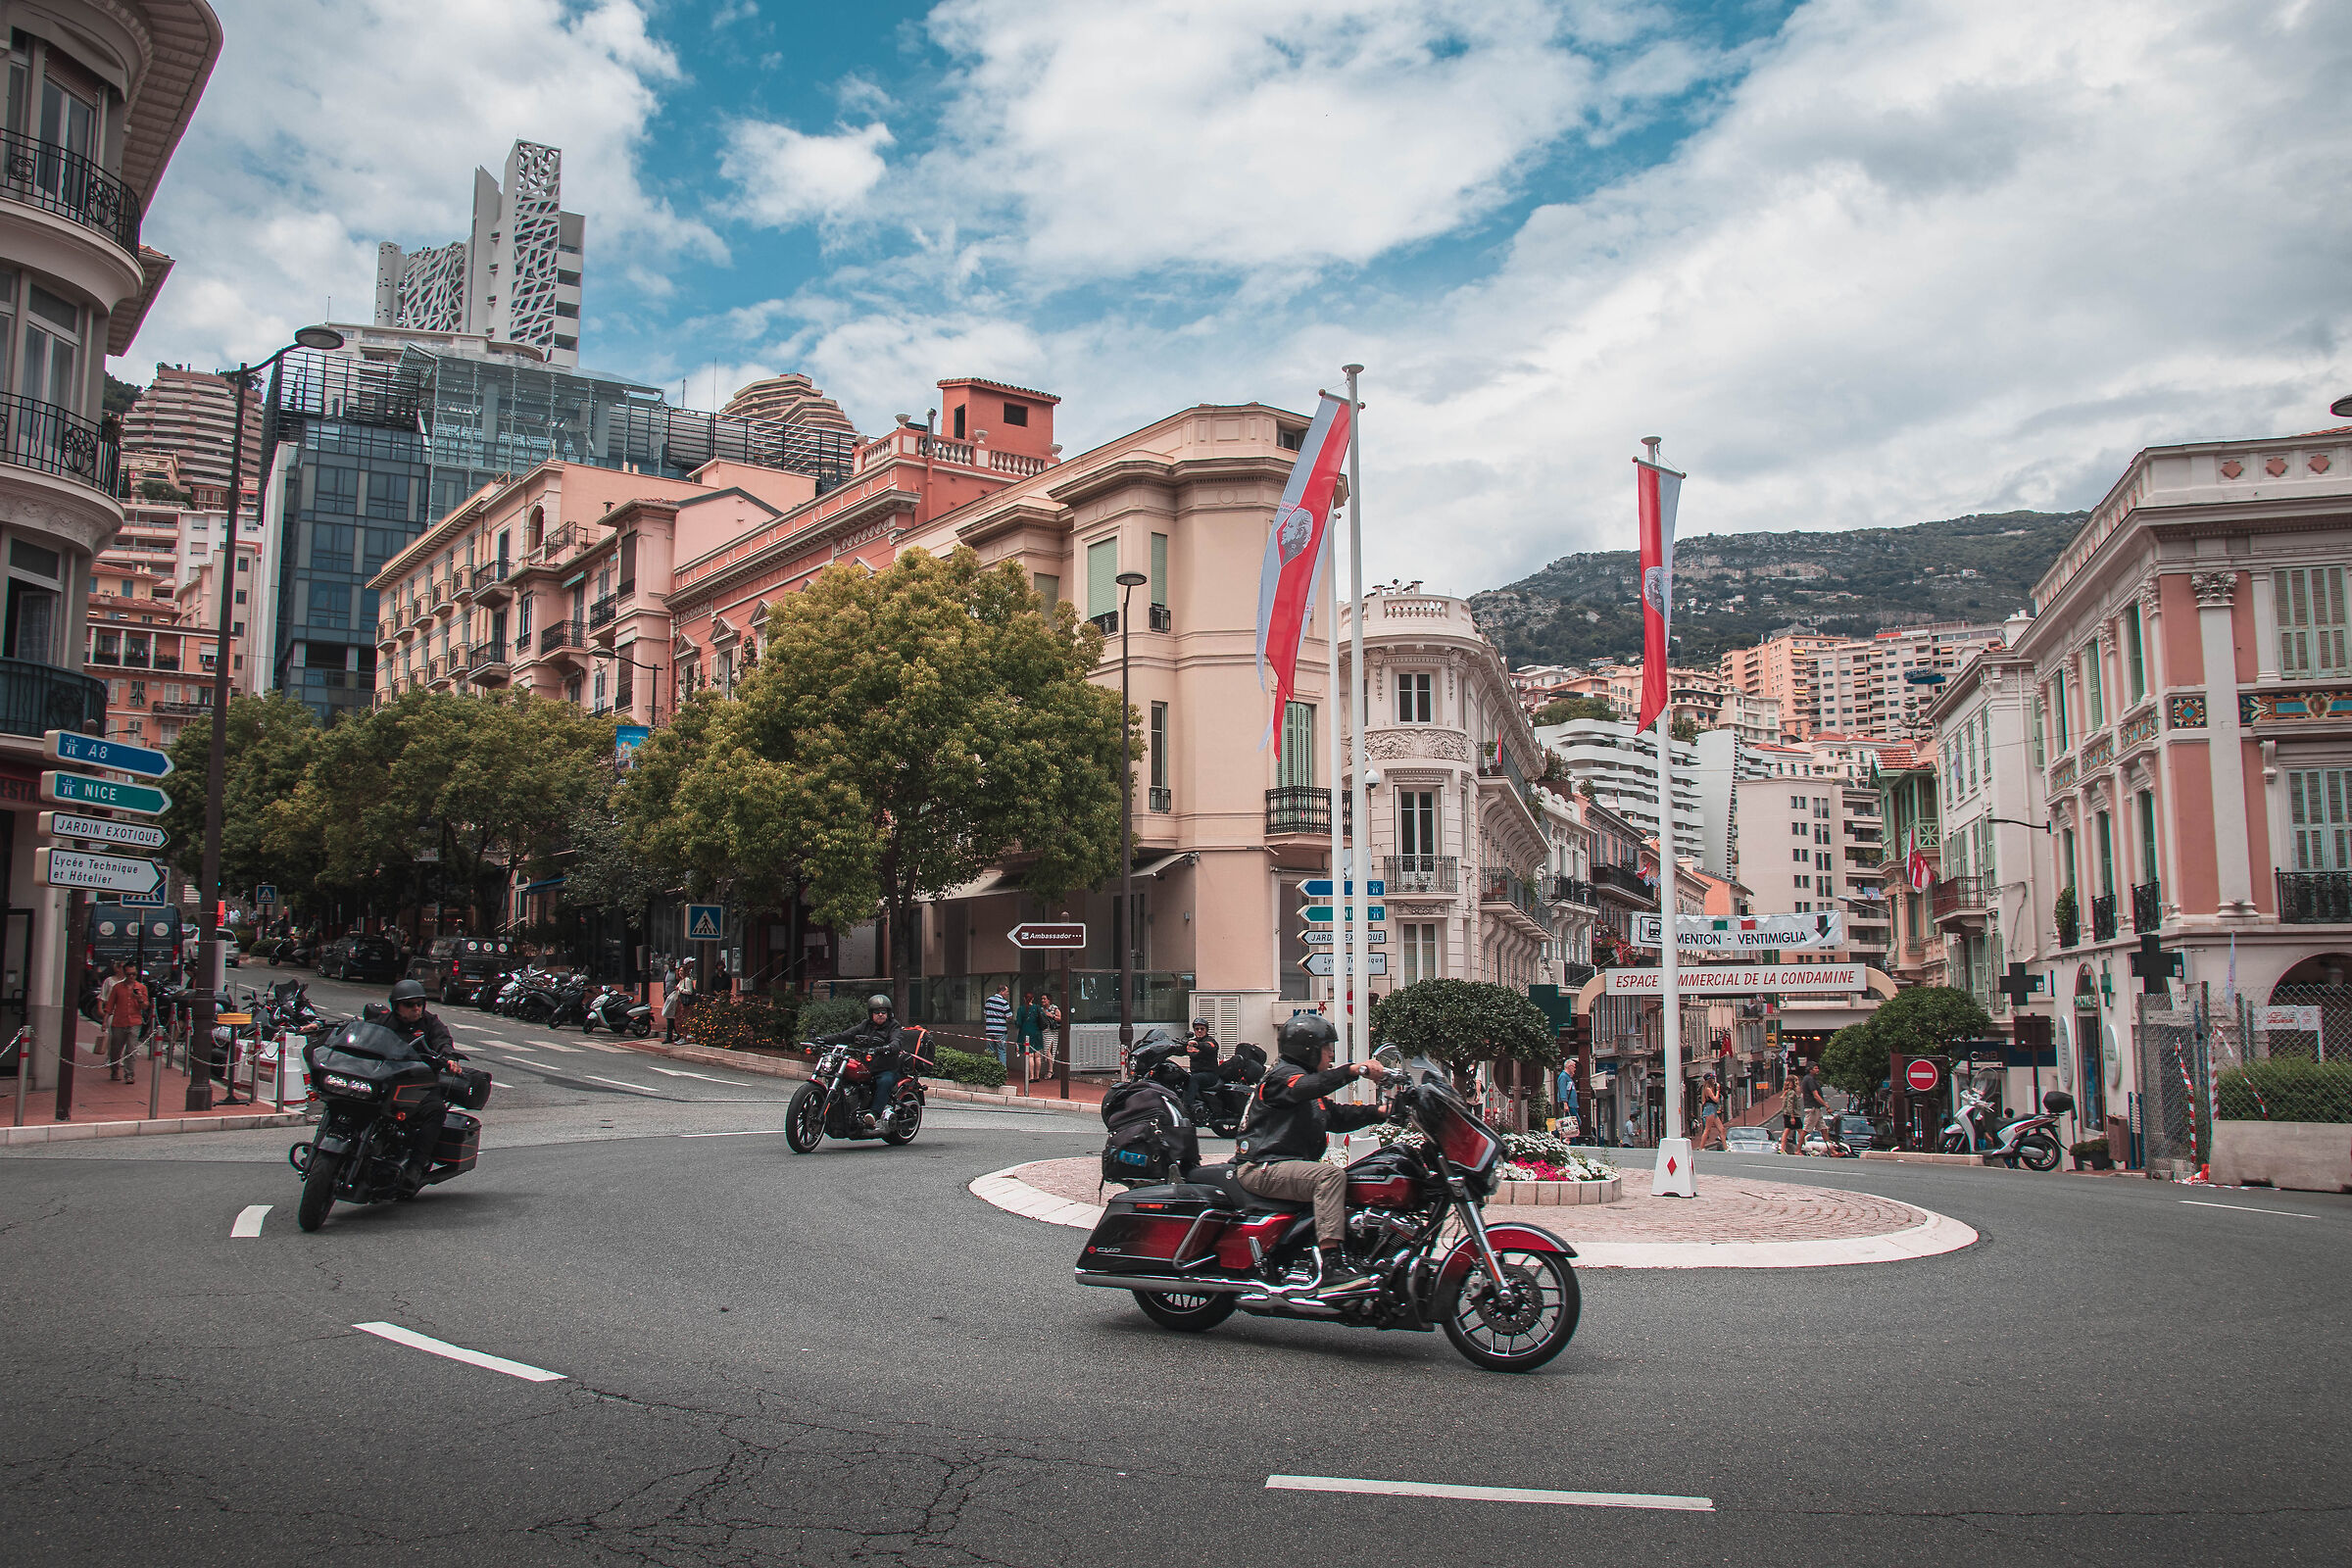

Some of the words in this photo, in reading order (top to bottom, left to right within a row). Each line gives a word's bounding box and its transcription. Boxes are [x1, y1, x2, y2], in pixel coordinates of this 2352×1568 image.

[87, 744, 109, 760] A8
[84, 783, 118, 801] NICE
[58, 819, 101, 835] JARDIN
[106, 826, 159, 843] EXOTIQUE
[54, 855, 84, 868] Lycée
[88, 858, 138, 875] Technique
[53, 870, 64, 880] et
[69, 870, 112, 884] Hôtelier
[1311, 933, 1332, 942] JARD
[1676, 932, 1722, 946] MENTON
[1738, 931, 1807, 946] VENTIMIGLIA
[1616, 974, 1658, 988] ESPACE
[1678, 972, 1740, 987] MMERCIAL
[1744, 972, 1758, 986] DE
[1764, 972, 1777, 985] LA
[1781, 970, 1854, 985] CONDAMINE
